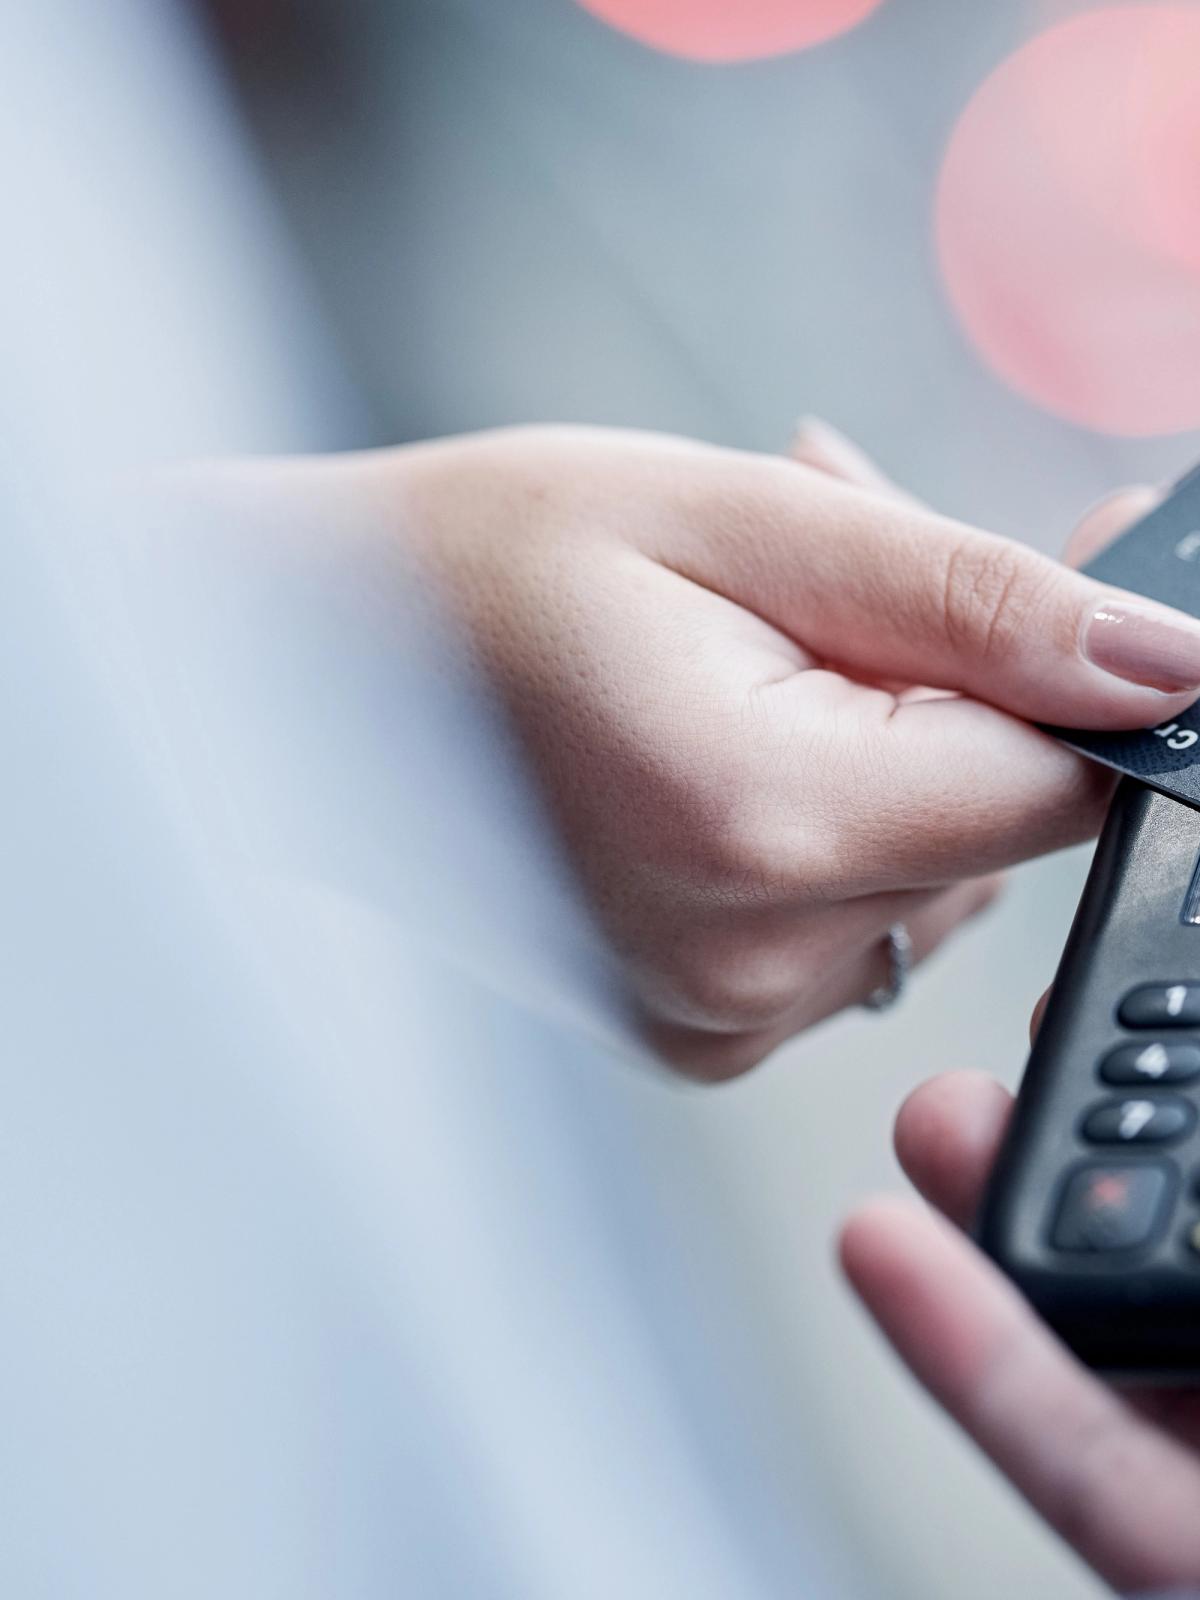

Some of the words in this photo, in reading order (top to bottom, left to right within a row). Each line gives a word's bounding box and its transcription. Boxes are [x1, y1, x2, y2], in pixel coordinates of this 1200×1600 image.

[1165, 984, 1187, 1015] 1
[1135, 1043, 1170, 1077] 4
[1119, 1100, 1156, 1138] 7
